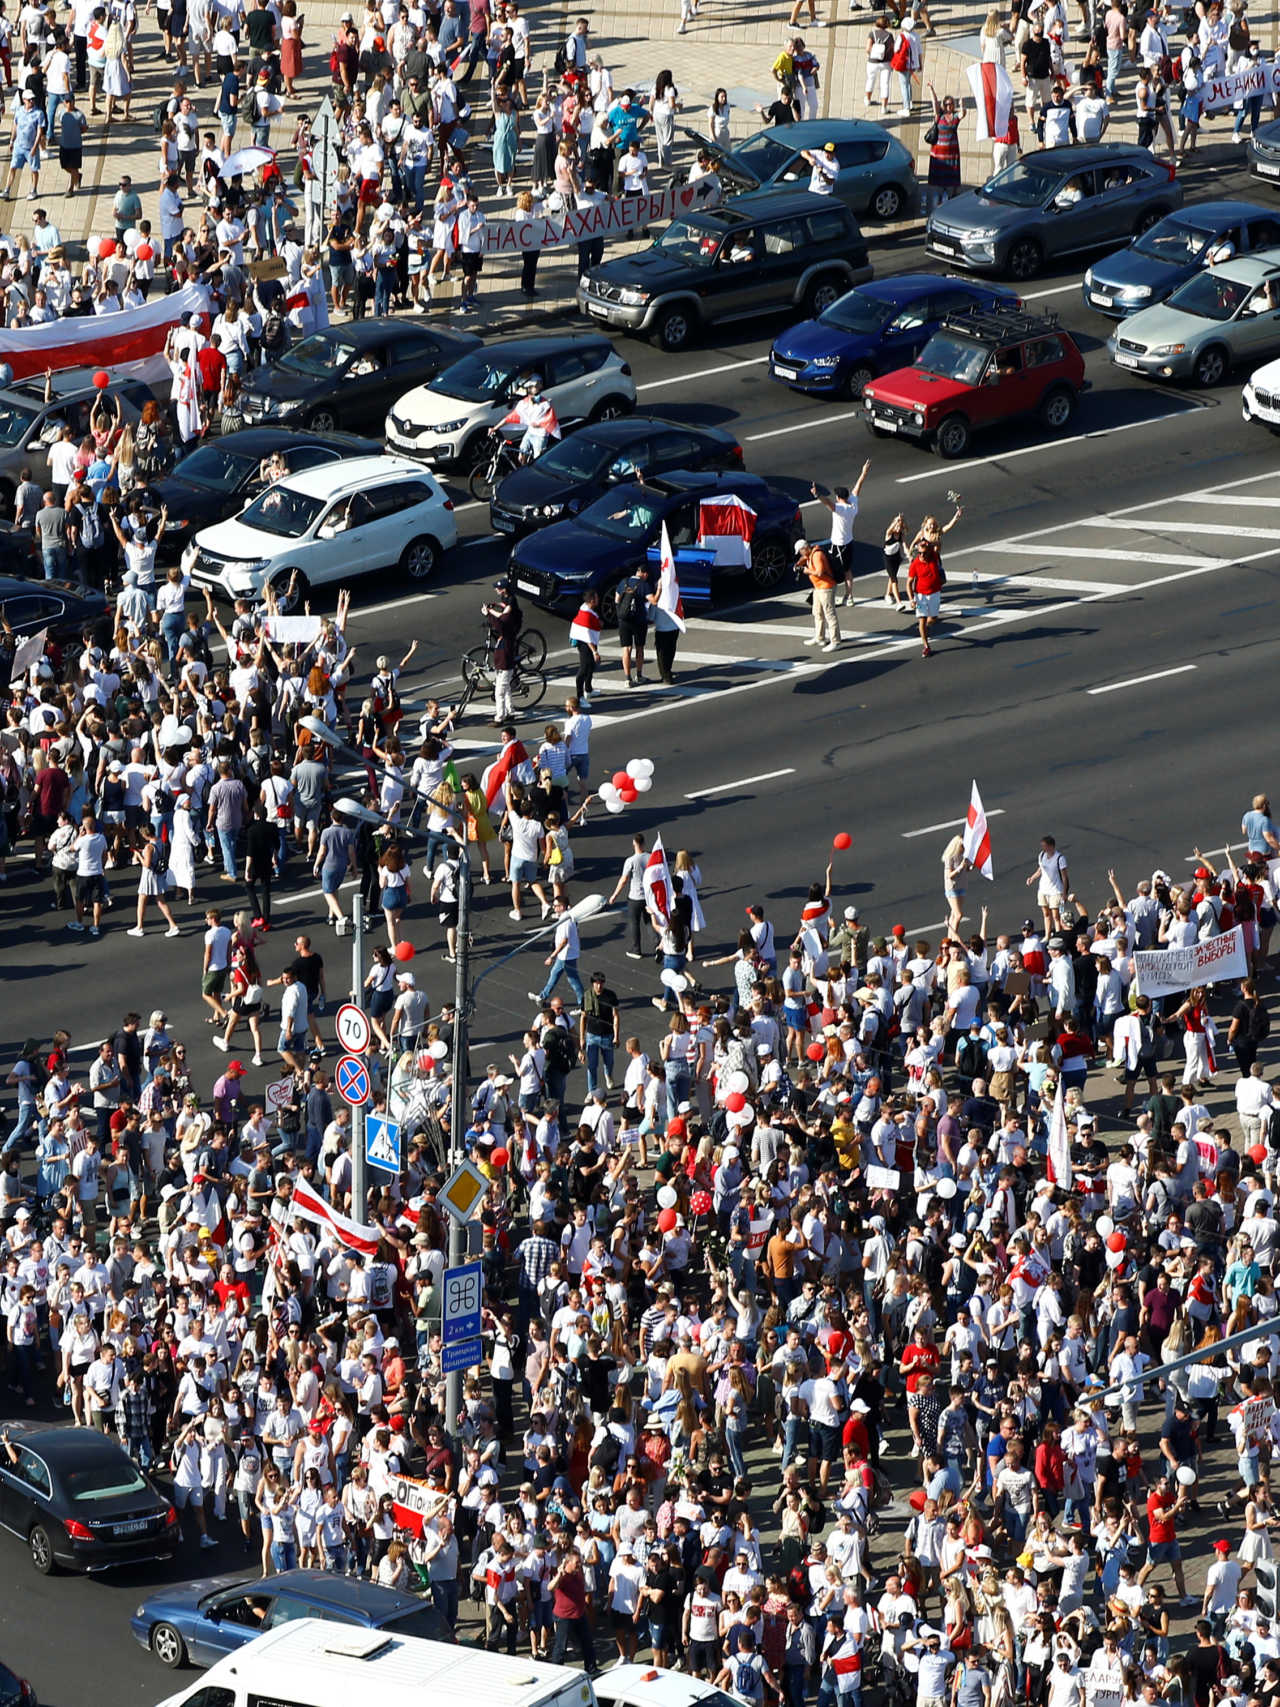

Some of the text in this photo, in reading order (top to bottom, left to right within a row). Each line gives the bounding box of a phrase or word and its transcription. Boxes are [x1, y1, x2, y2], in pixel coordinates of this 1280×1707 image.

[1208, 70, 1265, 102] МЕДИКИ
[487, 223, 532, 250] НАС
[1206, 931, 1237, 952] ЧЕСТНЫЕ
[1197, 942, 1236, 968] ВЫБОРЫ
[344, 1018, 361, 1039] 70
[448, 1325, 454, 1336] 2
